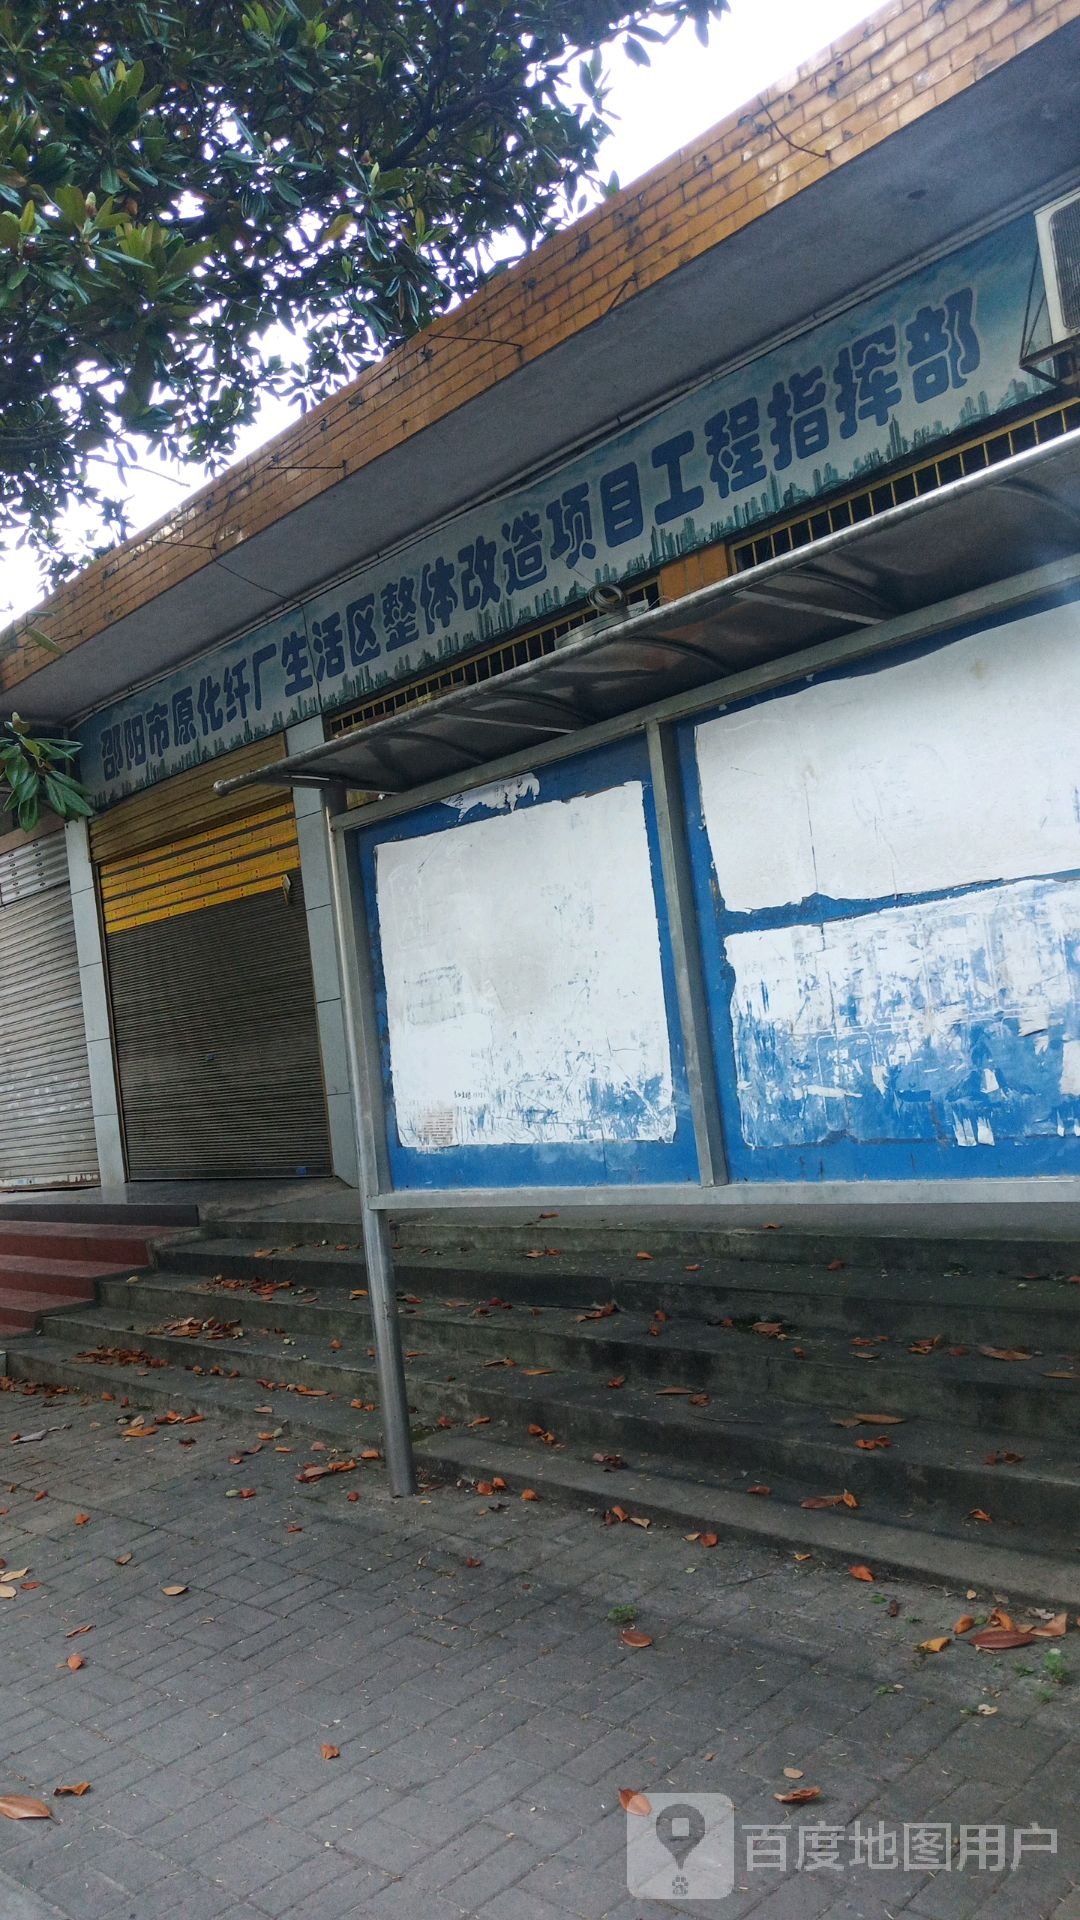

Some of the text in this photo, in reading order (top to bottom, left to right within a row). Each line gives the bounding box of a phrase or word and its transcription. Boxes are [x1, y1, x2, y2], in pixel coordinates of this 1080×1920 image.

[100, 287, 980, 781] 邵阳市原化纤厂生活区整体改造项目工程指挥部
